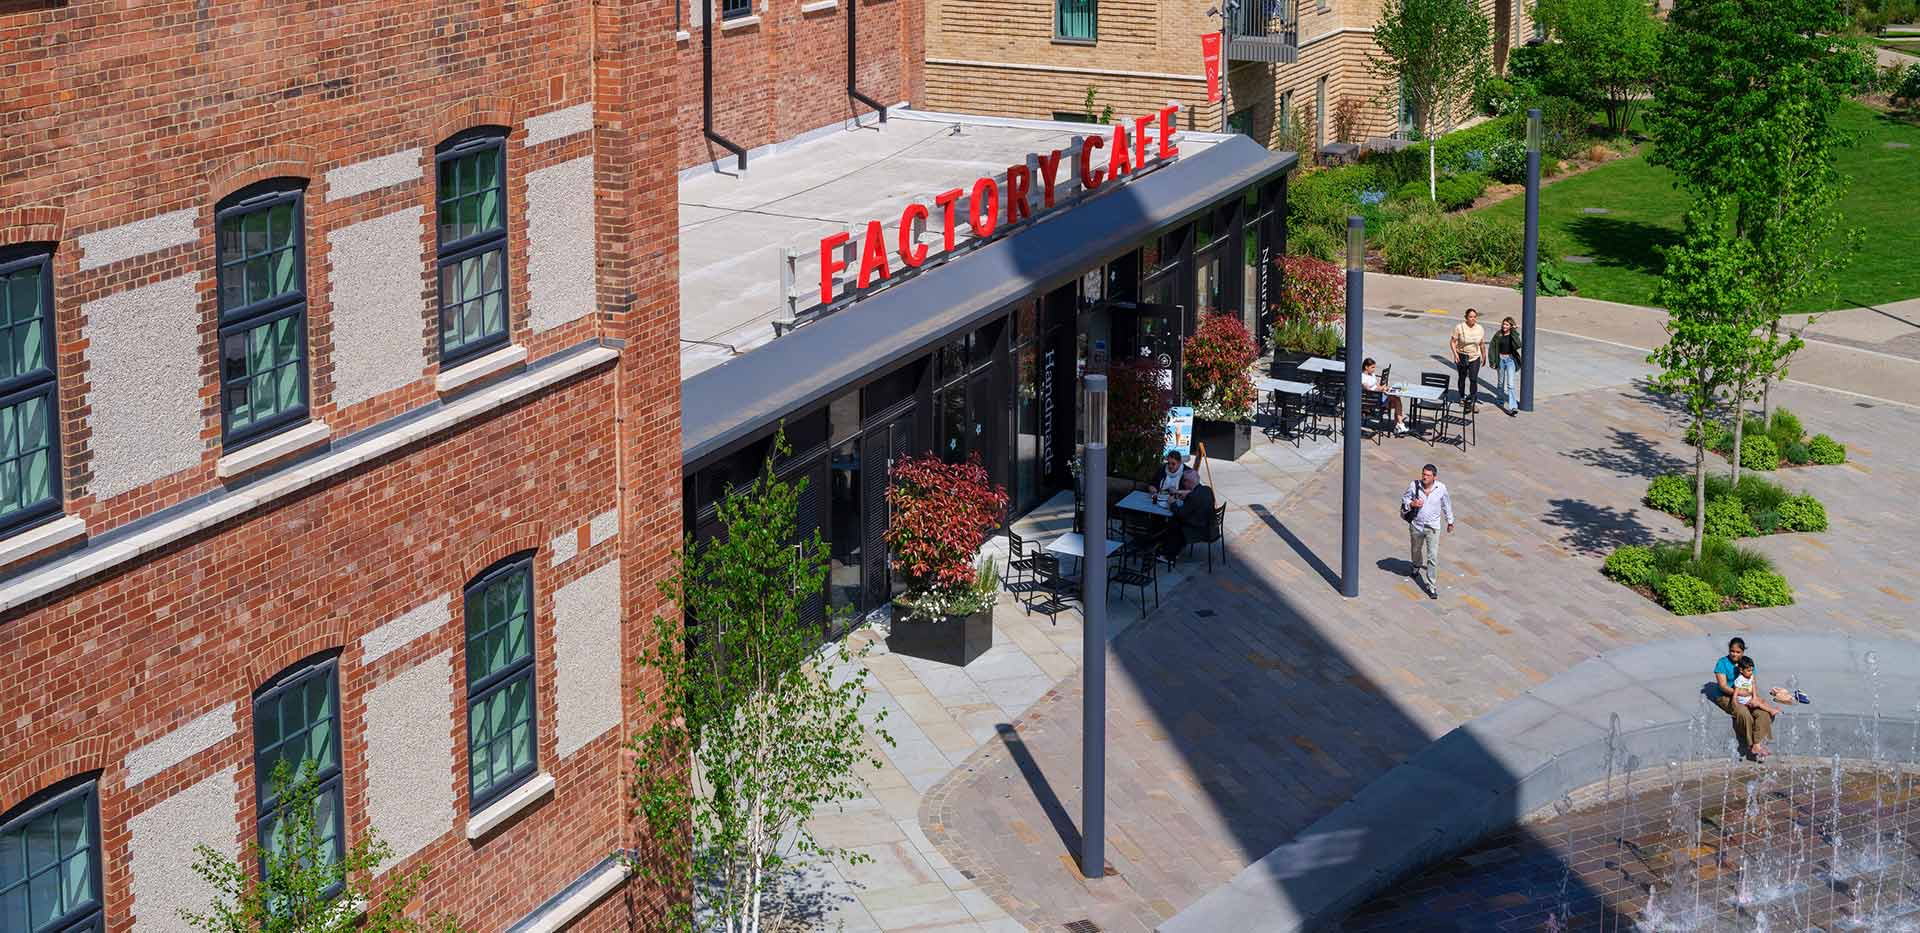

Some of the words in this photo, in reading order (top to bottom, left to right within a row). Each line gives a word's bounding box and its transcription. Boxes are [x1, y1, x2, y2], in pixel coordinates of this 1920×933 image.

[820, 149, 1062, 304] FACTORY
[1080, 104, 1180, 189] CAFE
[1045, 349, 1055, 475] Handmade
